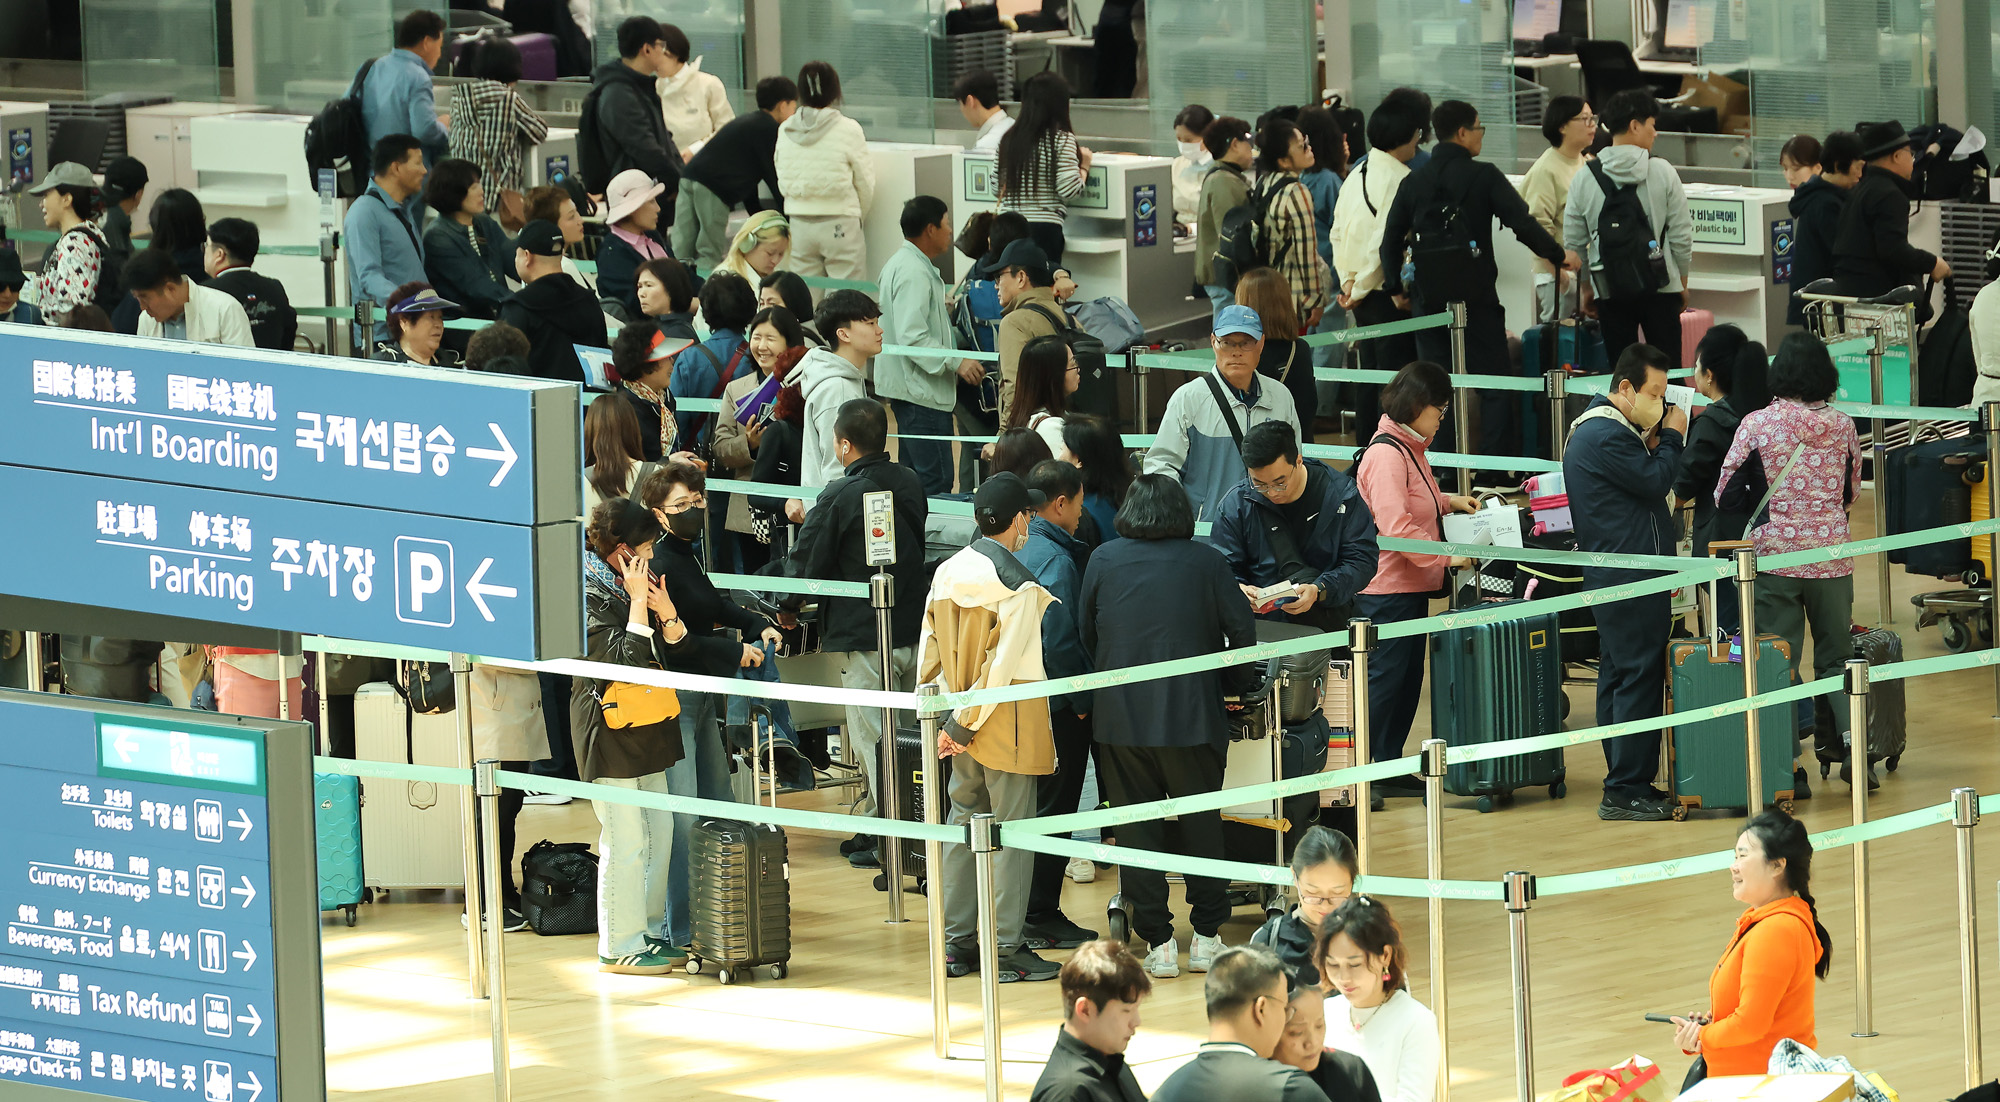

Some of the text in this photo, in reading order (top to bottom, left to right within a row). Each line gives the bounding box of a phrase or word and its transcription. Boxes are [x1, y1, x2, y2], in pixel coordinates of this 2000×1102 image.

[1696, 224, 1737, 235] plastic bag
[33, 359, 277, 422] 国際線搭乗 国际线登机
[91, 417, 278, 481] Int'l Boarding
[296, 411, 456, 477] 국제선탑승
[96, 500, 252, 552] 駐車場 停车场
[1607, 557, 1650, 568] Incheon Airport
[1843, 543, 1880, 555] Incheon Airport
[149, 555, 254, 611] Parking
[271, 537, 375, 602] 주차장
[411, 551, 444, 612] P
[823, 586, 863, 596] Incheon Airport
[1596, 589, 1635, 601] Incheon Airport
[1457, 613, 1497, 625] Incheon Airport
[1237, 648, 1279, 660] Incheon Airport
[92, 810, 133, 831] Toilets
[140, 800, 187, 831] 화장실
[28, 866, 150, 902] Currency Exchange
[8, 926, 113, 958] Beverages, Food
[119, 925, 191, 961] 음료, 식사
[87, 984, 122, 1015] Tax
[126, 990, 196, 1026] Refund
[210, 999, 225, 1013] TAX
[30, 1056, 82, 1081] Check-in
[91, 1050, 197, 1092] 큰 짐 부치는 곳
